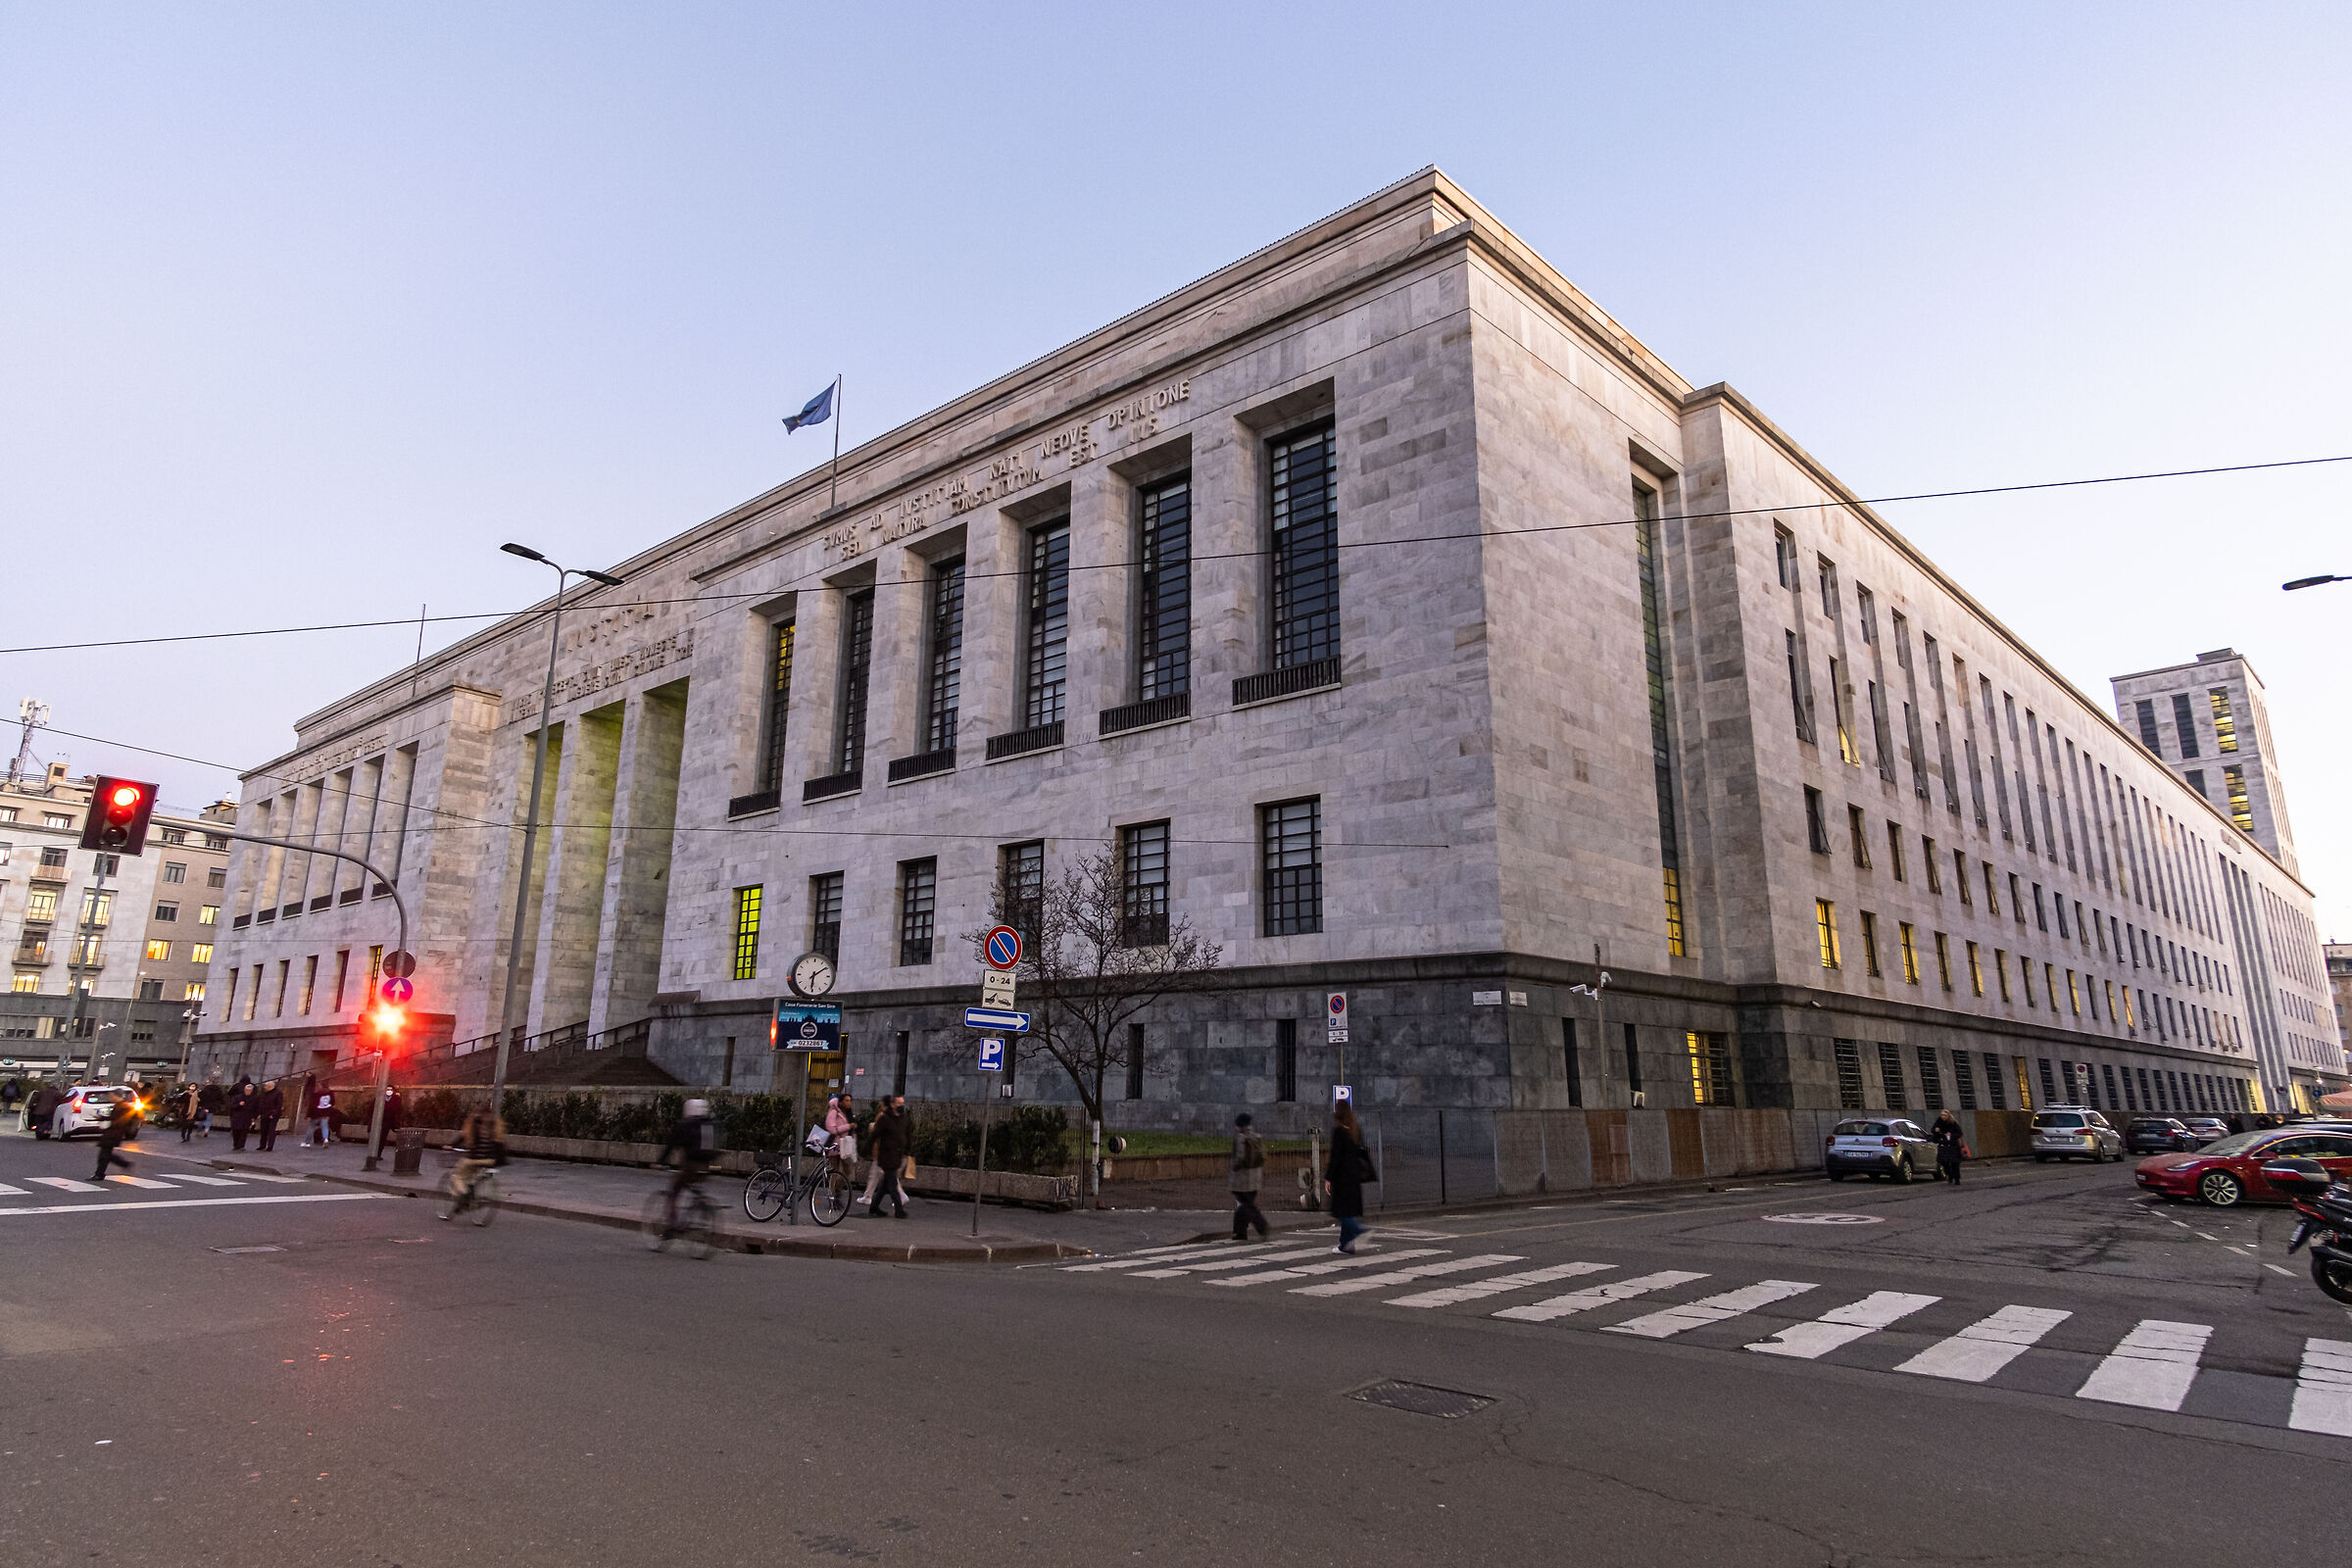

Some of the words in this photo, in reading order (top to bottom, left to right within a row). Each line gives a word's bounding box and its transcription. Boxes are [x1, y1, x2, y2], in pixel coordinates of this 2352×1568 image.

[823, 524, 857, 551] SVMVS
[869, 513, 884, 531] AD
[899, 474, 969, 518] IVSTITIAM
[989, 450, 1024, 480] NATI
[1107, 378, 1191, 431] OPINIONE
[841, 541, 863, 562] SED
[881, 515, 928, 544] NATVRA
[951, 466, 1044, 515] CONSTITVTVM
[1069, 442, 1099, 468] EST
[1130, 417, 1159, 444] IVS
[990, 975, 996, 984] 0
[982, 1039, 1002, 1059] P
[1336, 1087, 1349, 1100] P
